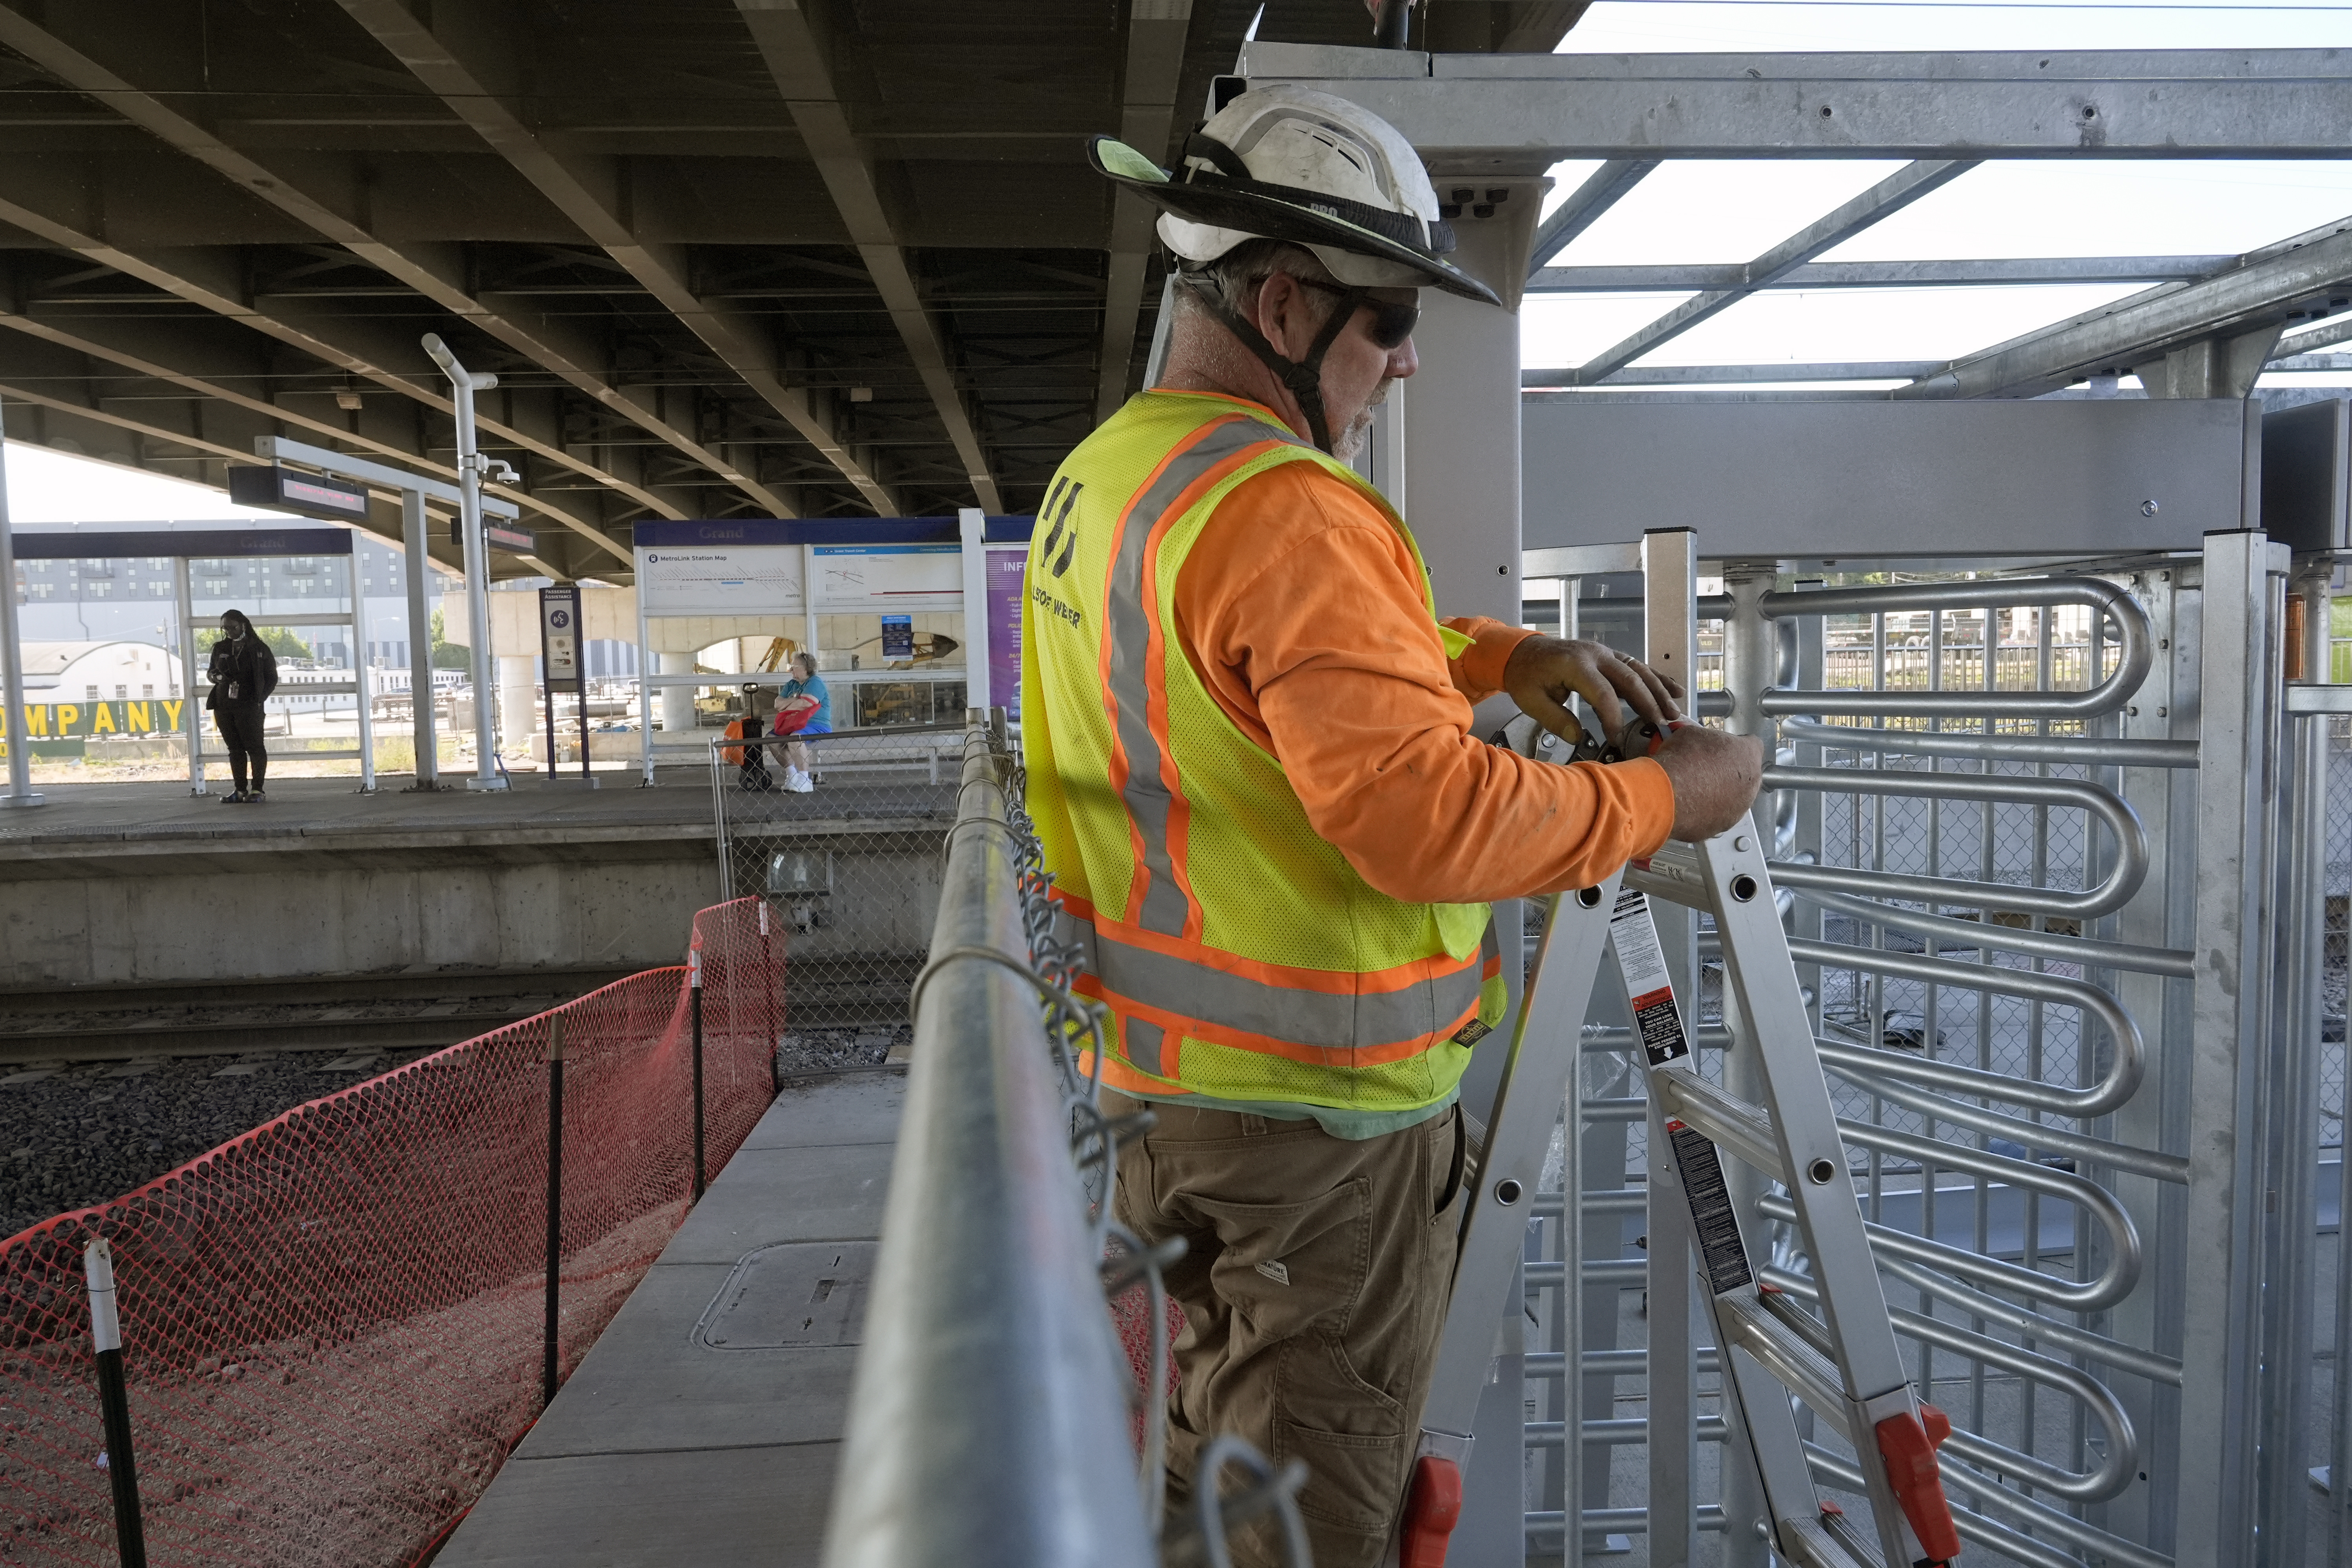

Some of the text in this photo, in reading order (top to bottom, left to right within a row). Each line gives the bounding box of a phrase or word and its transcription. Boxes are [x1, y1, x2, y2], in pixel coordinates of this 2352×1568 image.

[699, 526, 744, 538] Grand
[1642, 989, 1666, 1000] WARNING
[1641, 995, 1671, 1008] ADVERTENCIA
[1657, 1016, 1674, 1025] BALANCE
[1654, 1040, 1677, 1049] EQUILIBRIO.
